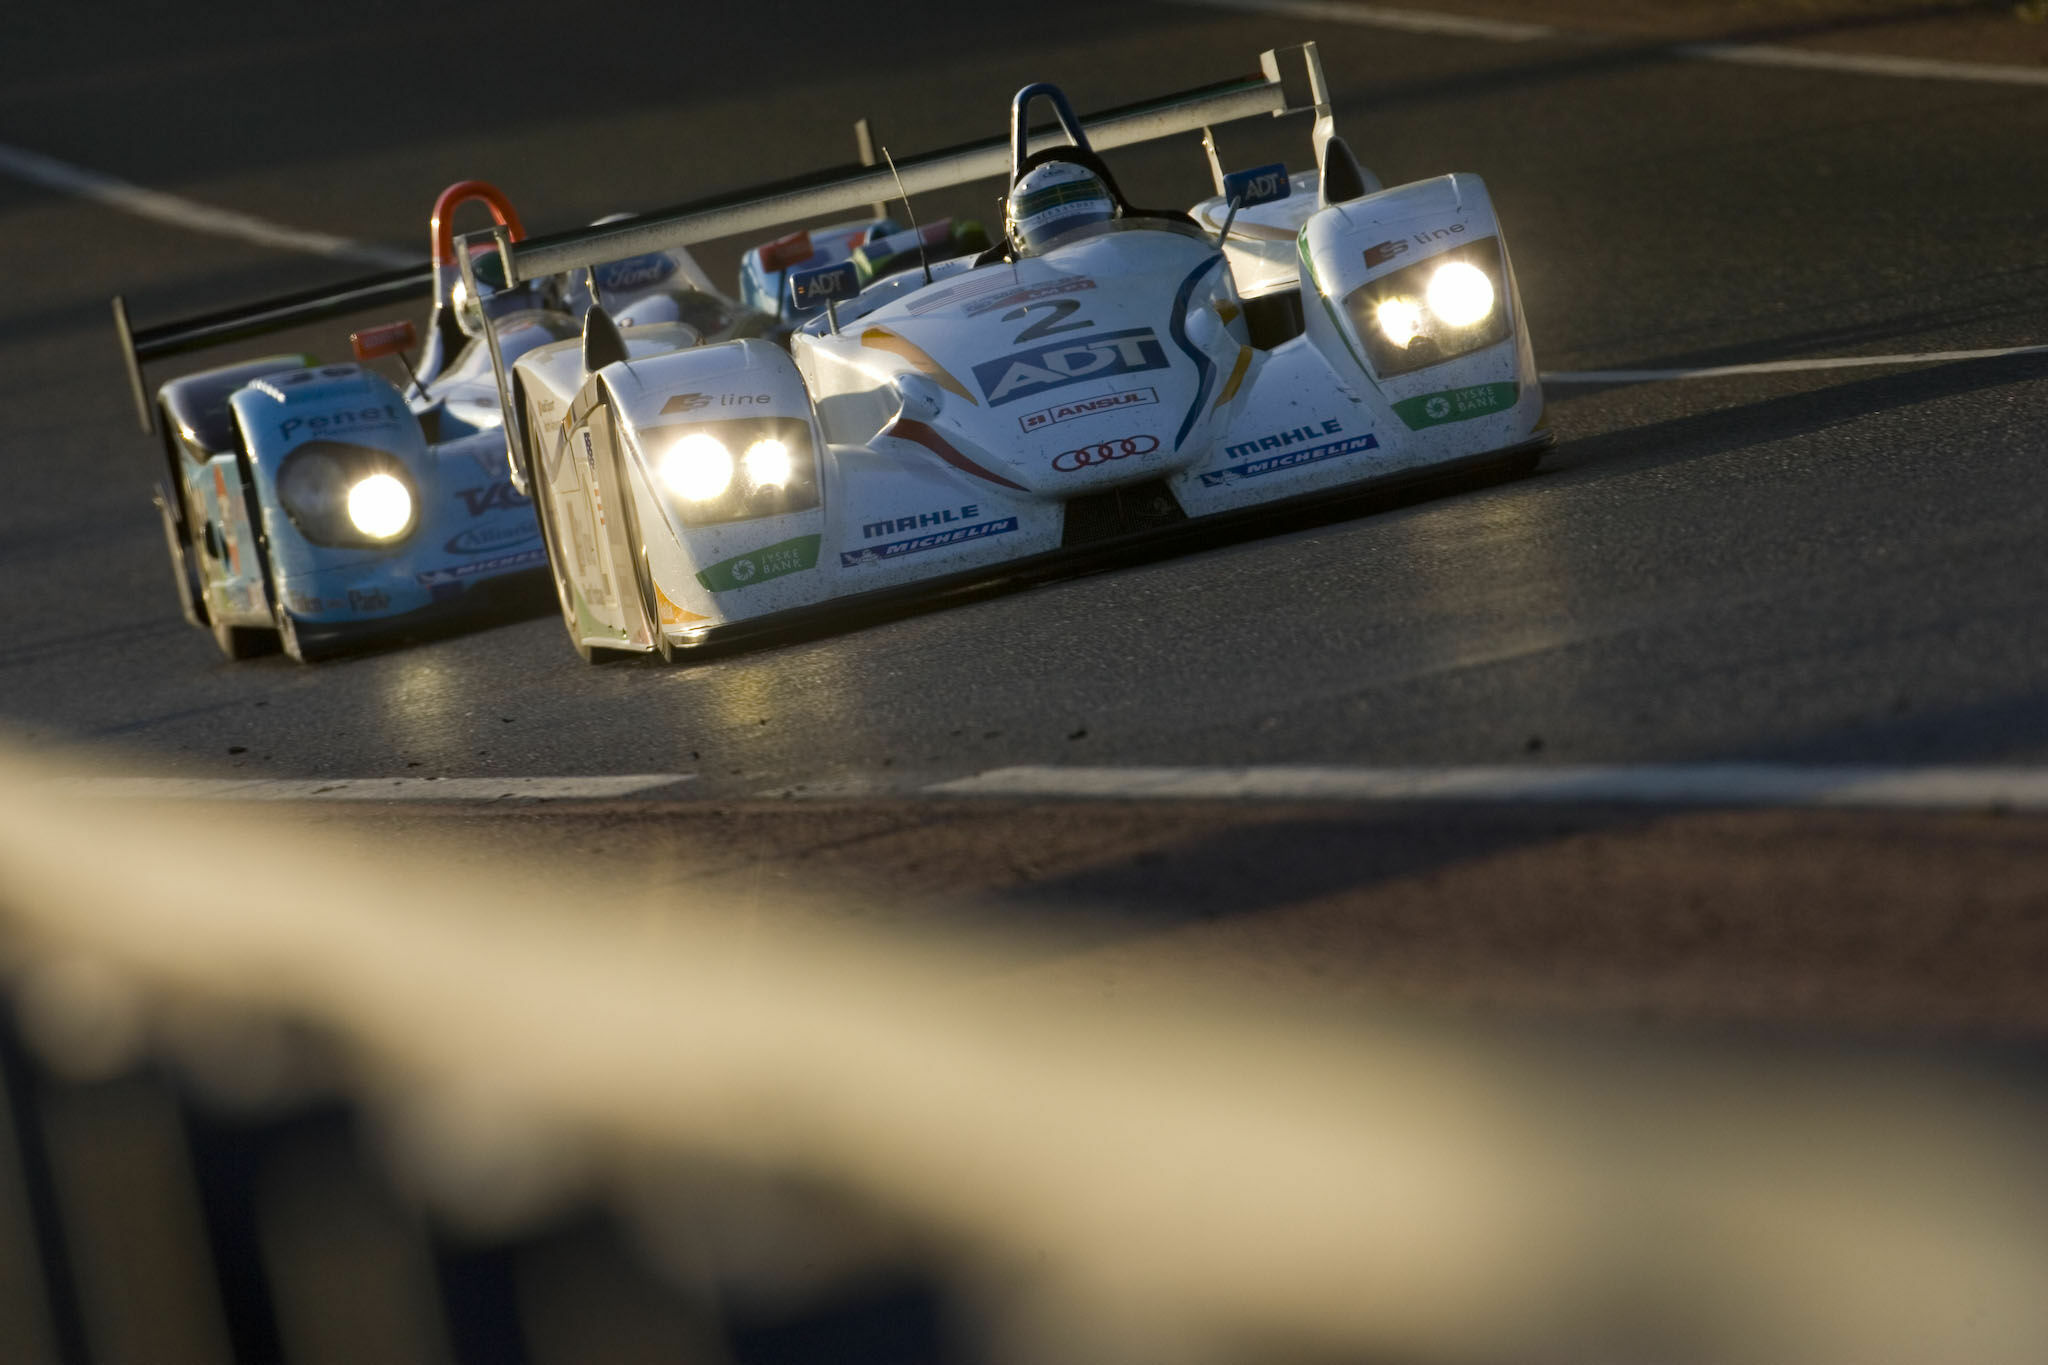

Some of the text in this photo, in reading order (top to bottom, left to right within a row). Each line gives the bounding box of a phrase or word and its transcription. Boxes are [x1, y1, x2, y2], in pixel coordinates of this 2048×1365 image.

[1245, 172, 1279, 199] ADT
[1413, 223, 1465, 245] line
[807, 271, 846, 298] ADT
[1002, 299, 1095, 344] 2
[988, 334, 1157, 401] ADT
[720, 393, 772, 407] line
[1057, 393, 1148, 418] ANSUL
[1455, 385, 1495, 402] JYSKE
[1457, 396, 1498, 412] BANK
[1225, 418, 1343, 459] MAHLE
[1247, 437, 1368, 474] MICHELIN
[863, 504, 979, 539] MAHLE
[886, 521, 1009, 555] MICHELIN
[761, 549, 799, 565] JYSKE
[763, 559, 801, 575] BANK
